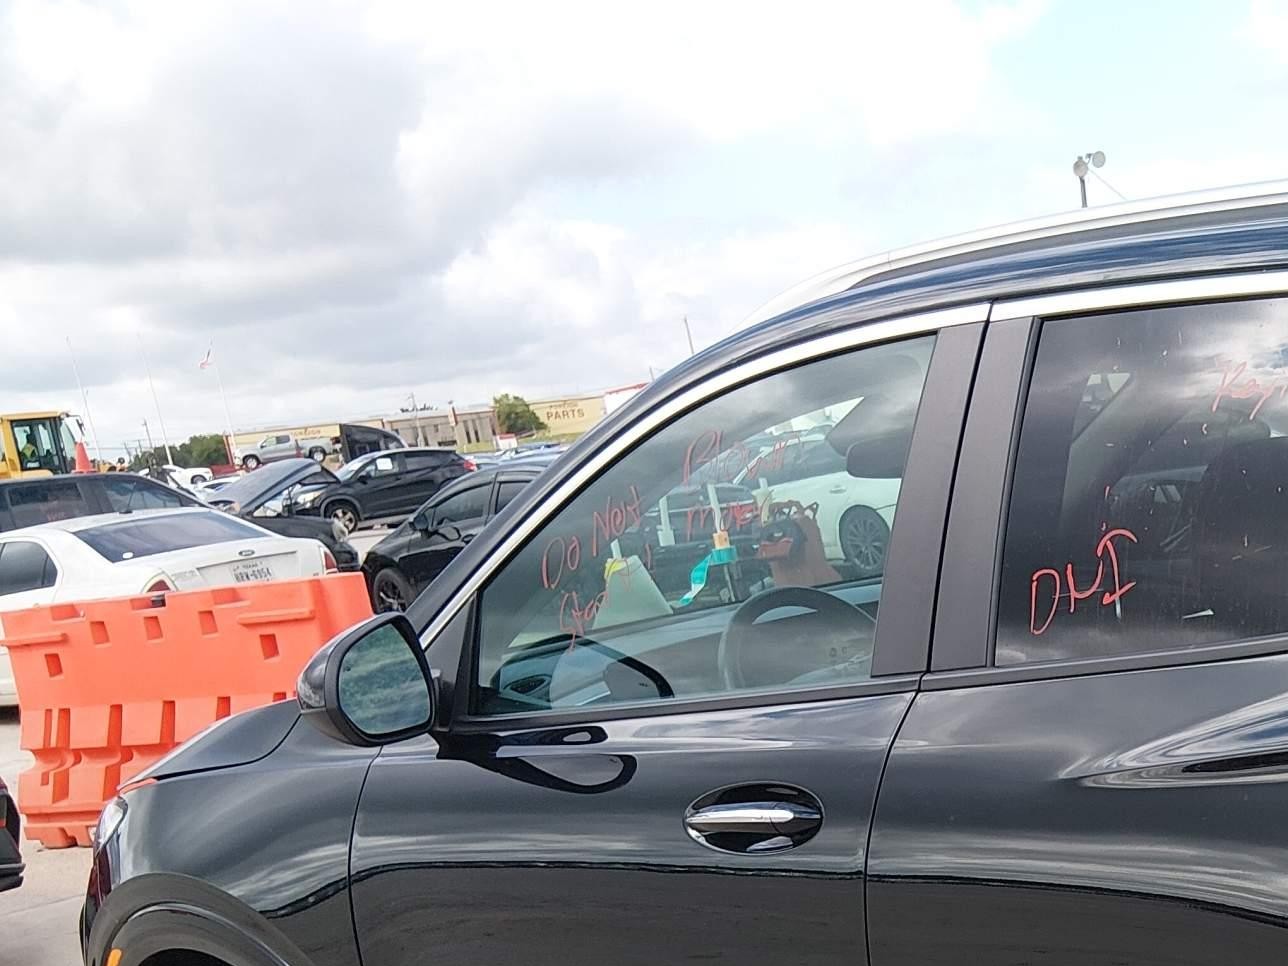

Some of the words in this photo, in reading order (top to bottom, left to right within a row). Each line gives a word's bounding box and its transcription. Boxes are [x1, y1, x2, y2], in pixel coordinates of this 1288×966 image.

[546, 408, 585, 421] PARTS
[542, 535, 581, 590] Do
[592, 485, 643, 557] Not
